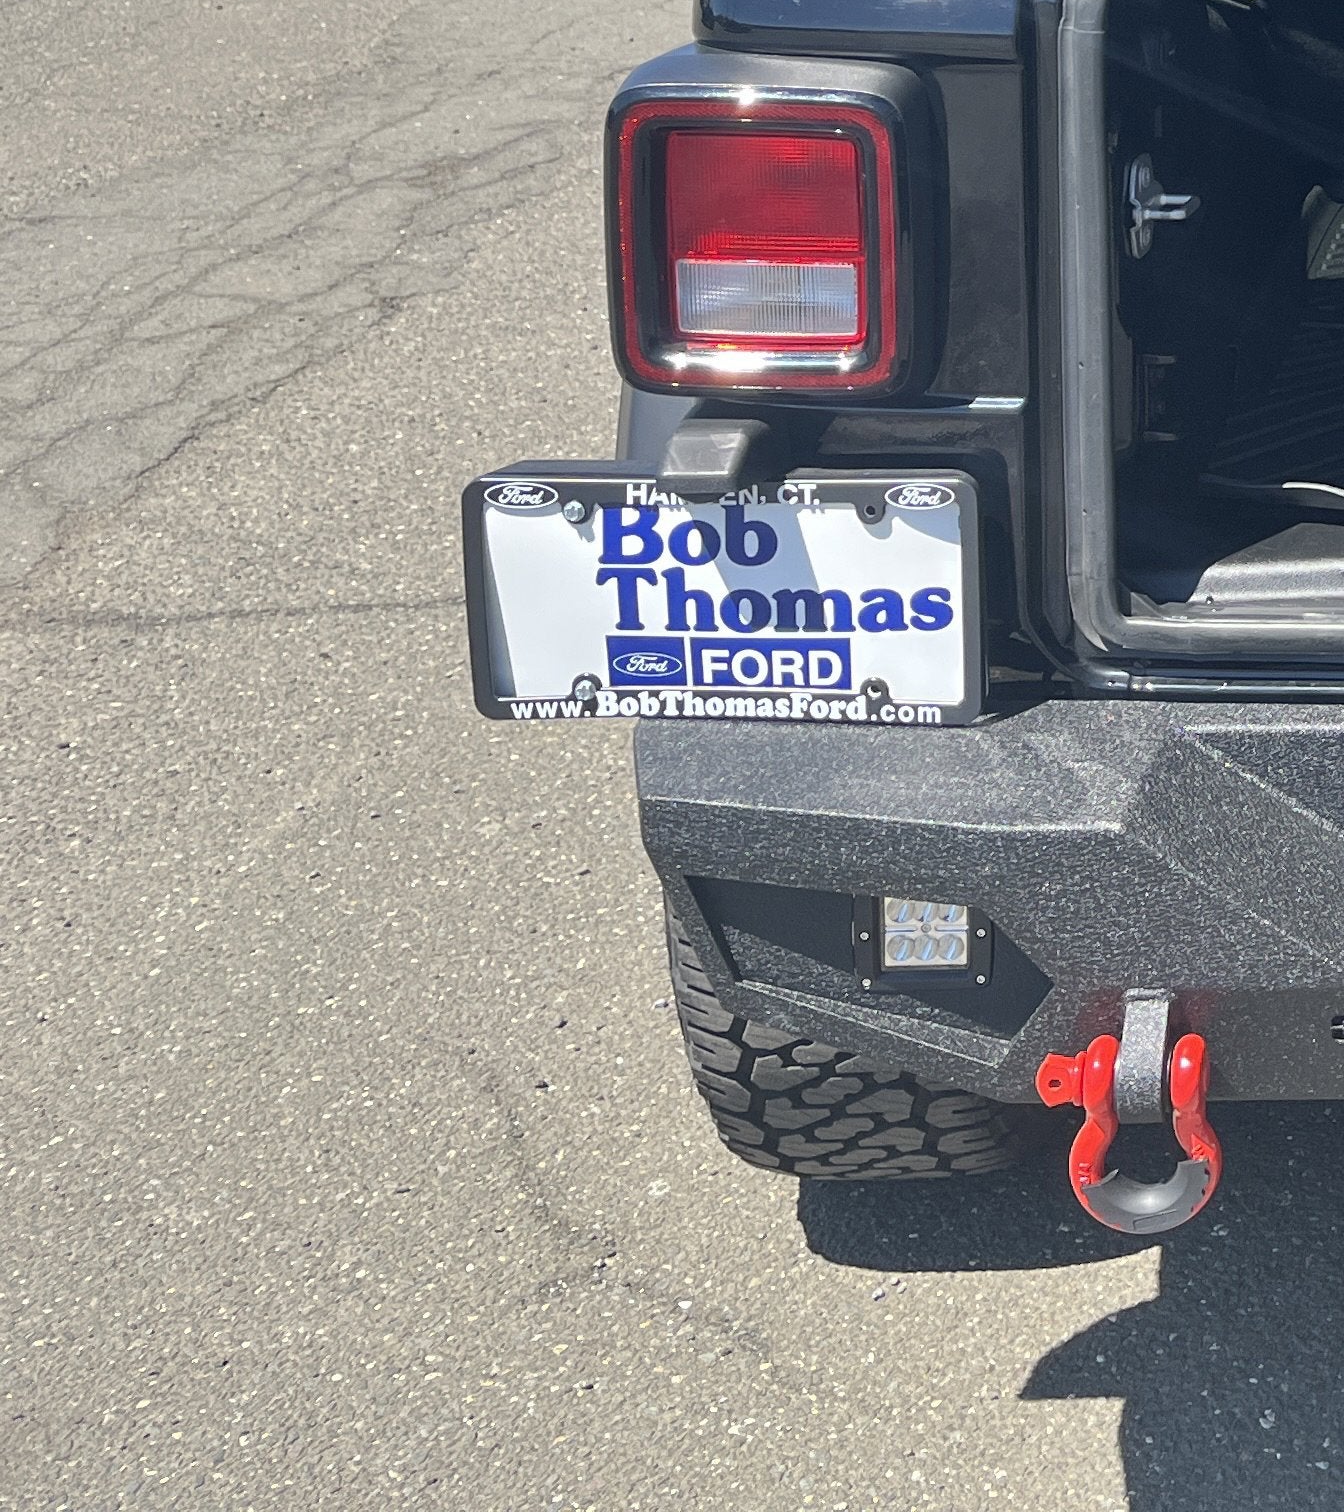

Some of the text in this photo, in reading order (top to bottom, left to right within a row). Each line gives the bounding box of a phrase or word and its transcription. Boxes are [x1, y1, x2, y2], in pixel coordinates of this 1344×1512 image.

[598, 504, 778, 566] Bob
[596, 567, 954, 633] Thomas
[701, 648, 845, 687] FORD
[511, 690, 942, 724] www.BobThomasFord.com
